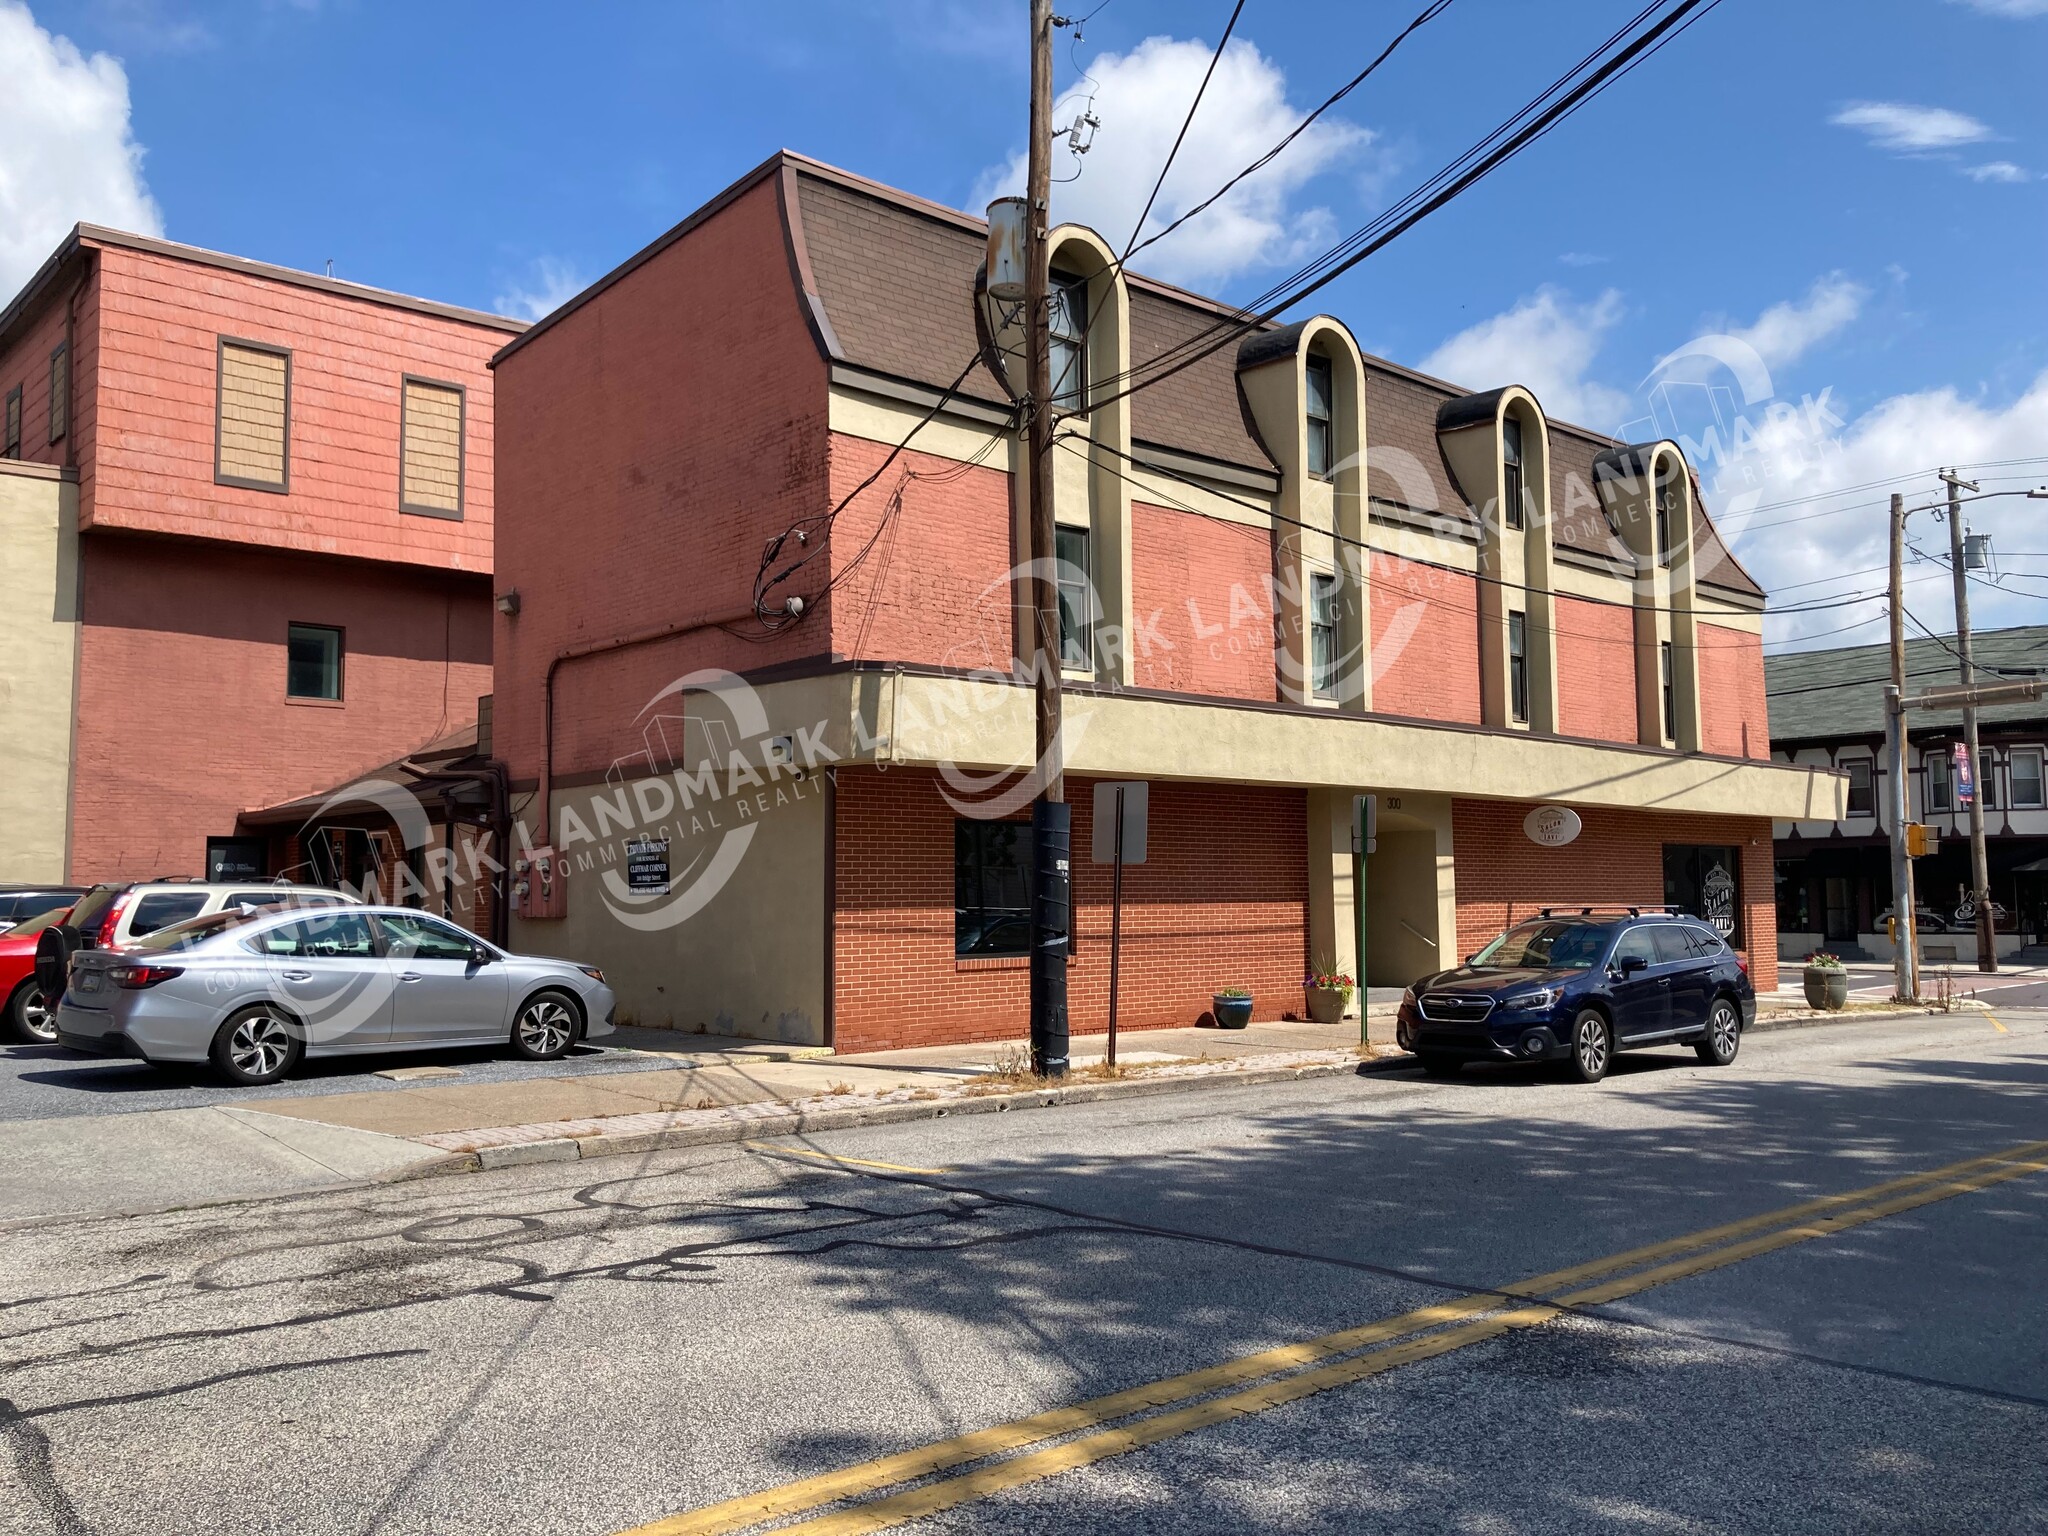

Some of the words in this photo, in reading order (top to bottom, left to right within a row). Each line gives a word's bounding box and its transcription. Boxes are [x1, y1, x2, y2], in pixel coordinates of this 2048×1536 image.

[1387, 797, 1401, 809] 300
[647, 843, 667, 852] PARKING
[650, 864, 667, 872] CORNER
